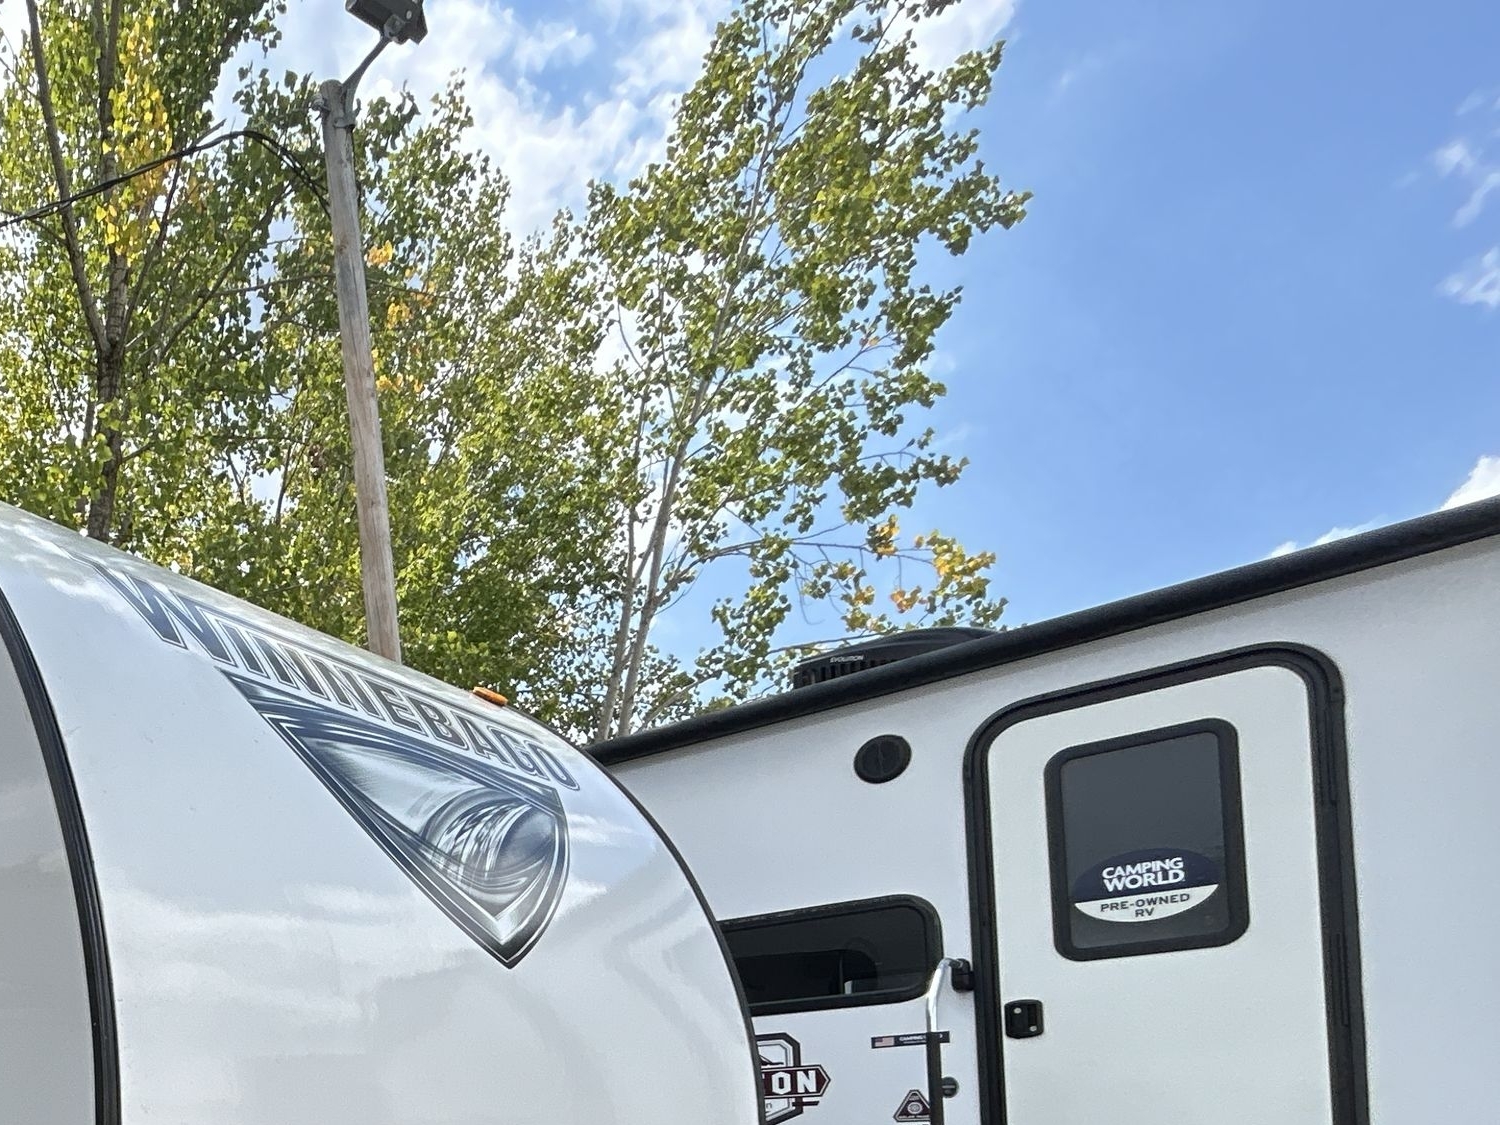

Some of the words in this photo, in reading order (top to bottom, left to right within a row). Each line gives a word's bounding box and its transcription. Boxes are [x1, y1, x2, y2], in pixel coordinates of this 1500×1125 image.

[90, 560, 580, 791] WINNEBAGO
[1102, 857, 1184, 879] CAMPING
[1103, 869, 1186, 893] WORLD
[1100, 893, 1190, 913] PRE-OWNED
[1135, 908, 1155, 918] RV
[761, 1070, 817, 1095] ON
